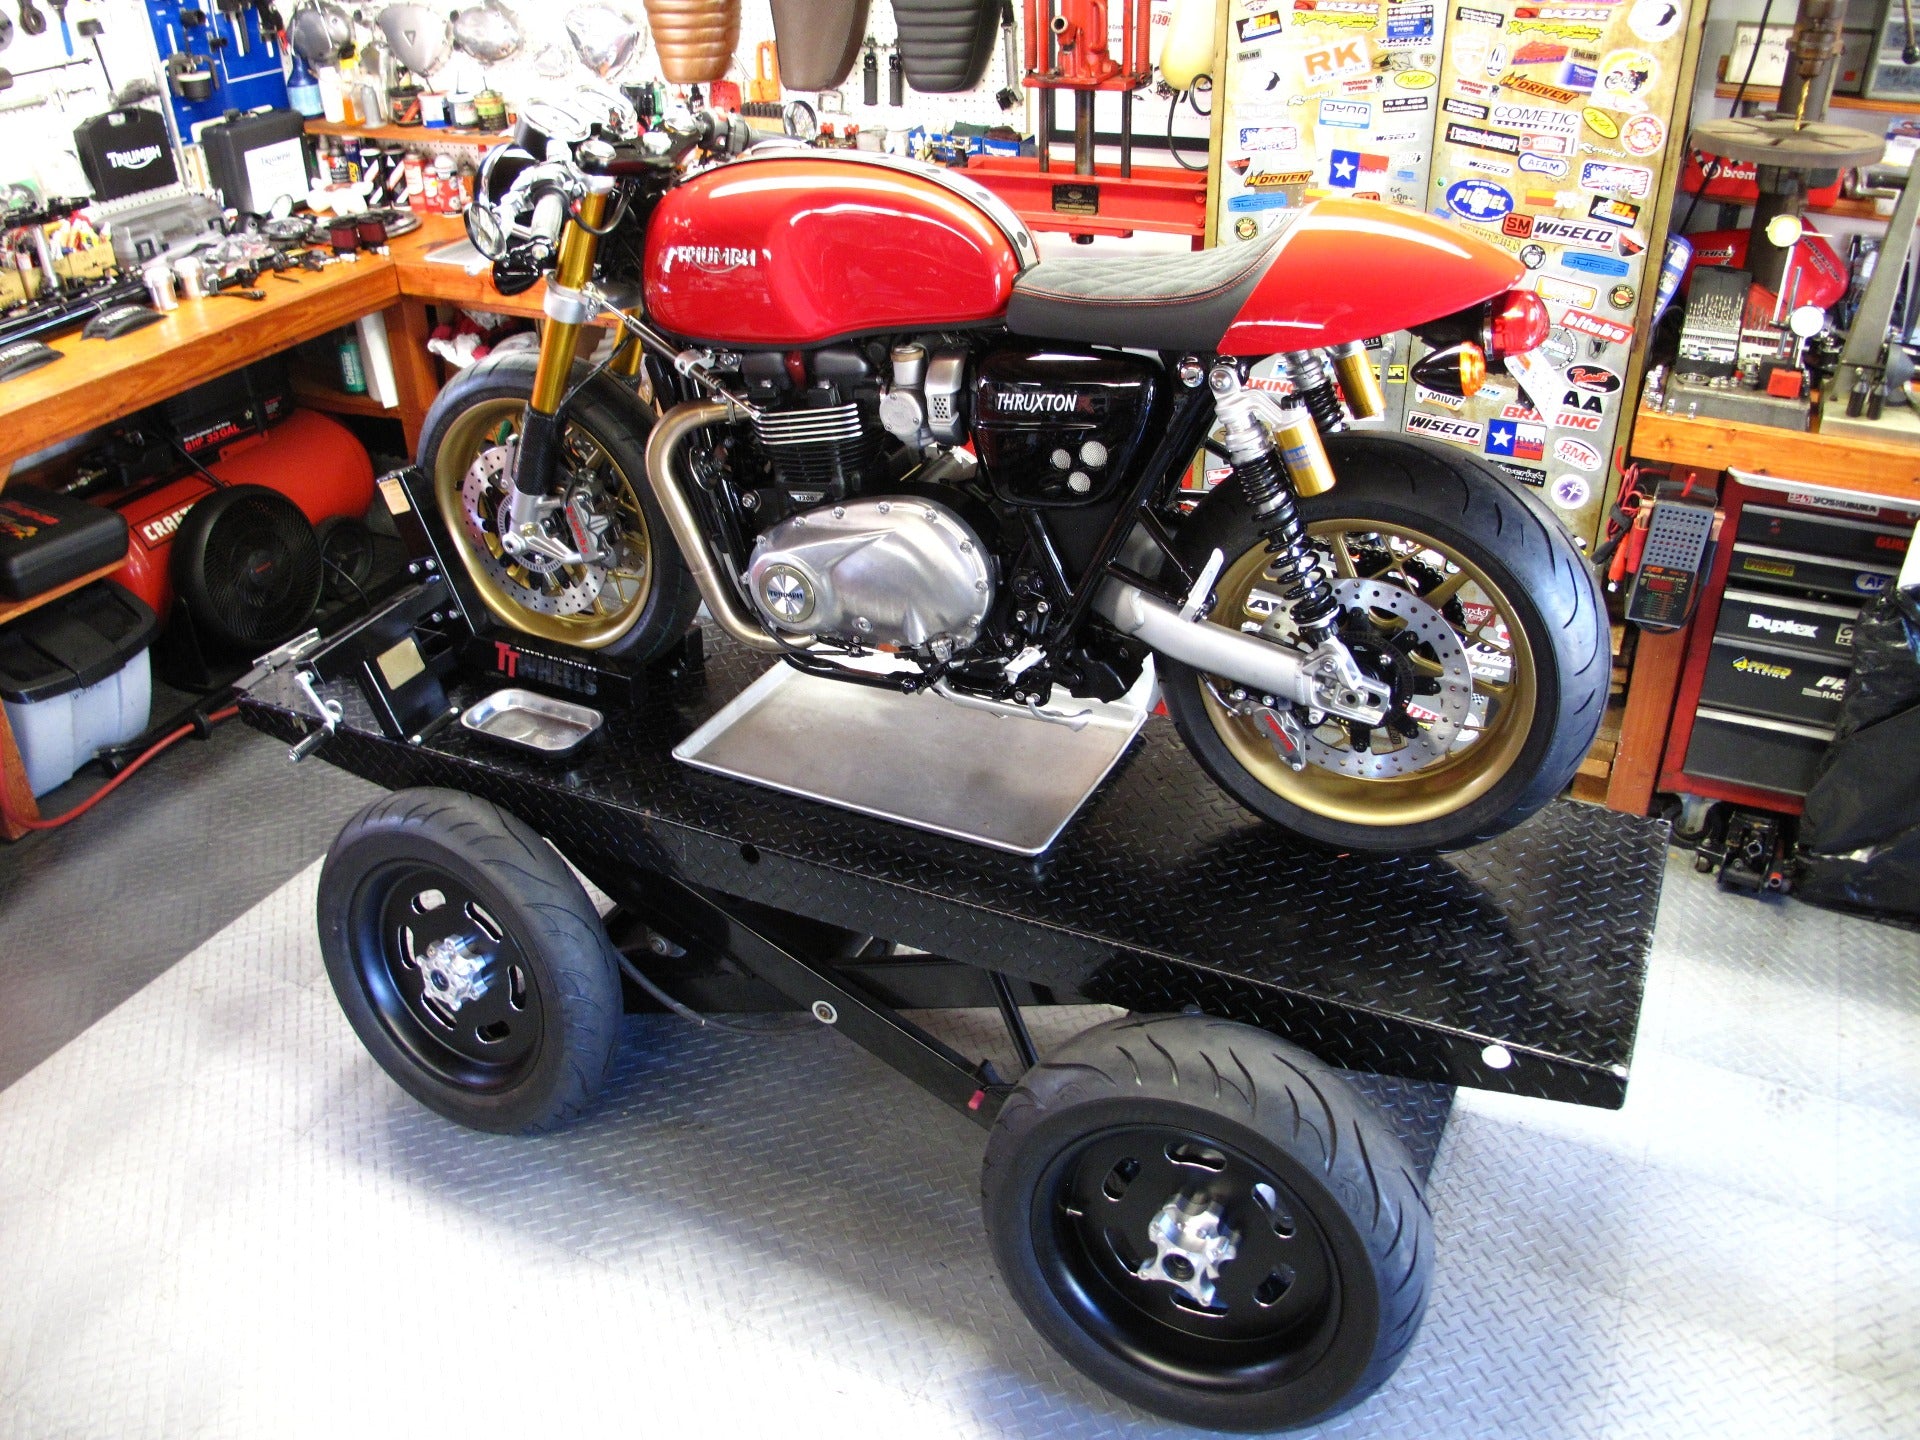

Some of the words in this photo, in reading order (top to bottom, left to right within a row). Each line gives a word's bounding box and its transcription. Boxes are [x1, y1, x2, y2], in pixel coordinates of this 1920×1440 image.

[1304, 41, 1362, 77] RK
[1517, 82, 1573, 103] DRIVEN
[1494, 106, 1579, 126] COMETIC
[106, 145, 162, 169] TRIUMPH
[1527, 159, 1560, 171] AFAM
[1259, 173, 1309, 185] DRIVEN
[1723, 168, 1757, 181] brem
[1507, 217, 1532, 235] SM
[1534, 221, 1613, 243] WISECO
[1563, 311, 1625, 341] bitubo
[997, 392, 1077, 414] THRUXTON
[1408, 415, 1480, 439] WISECO
[1560, 442, 1597, 466] BMC
[1812, 496, 1878, 513] YOSHIMURA
[1748, 613, 1819, 639] Duplex
[494, 641, 520, 679] TT
